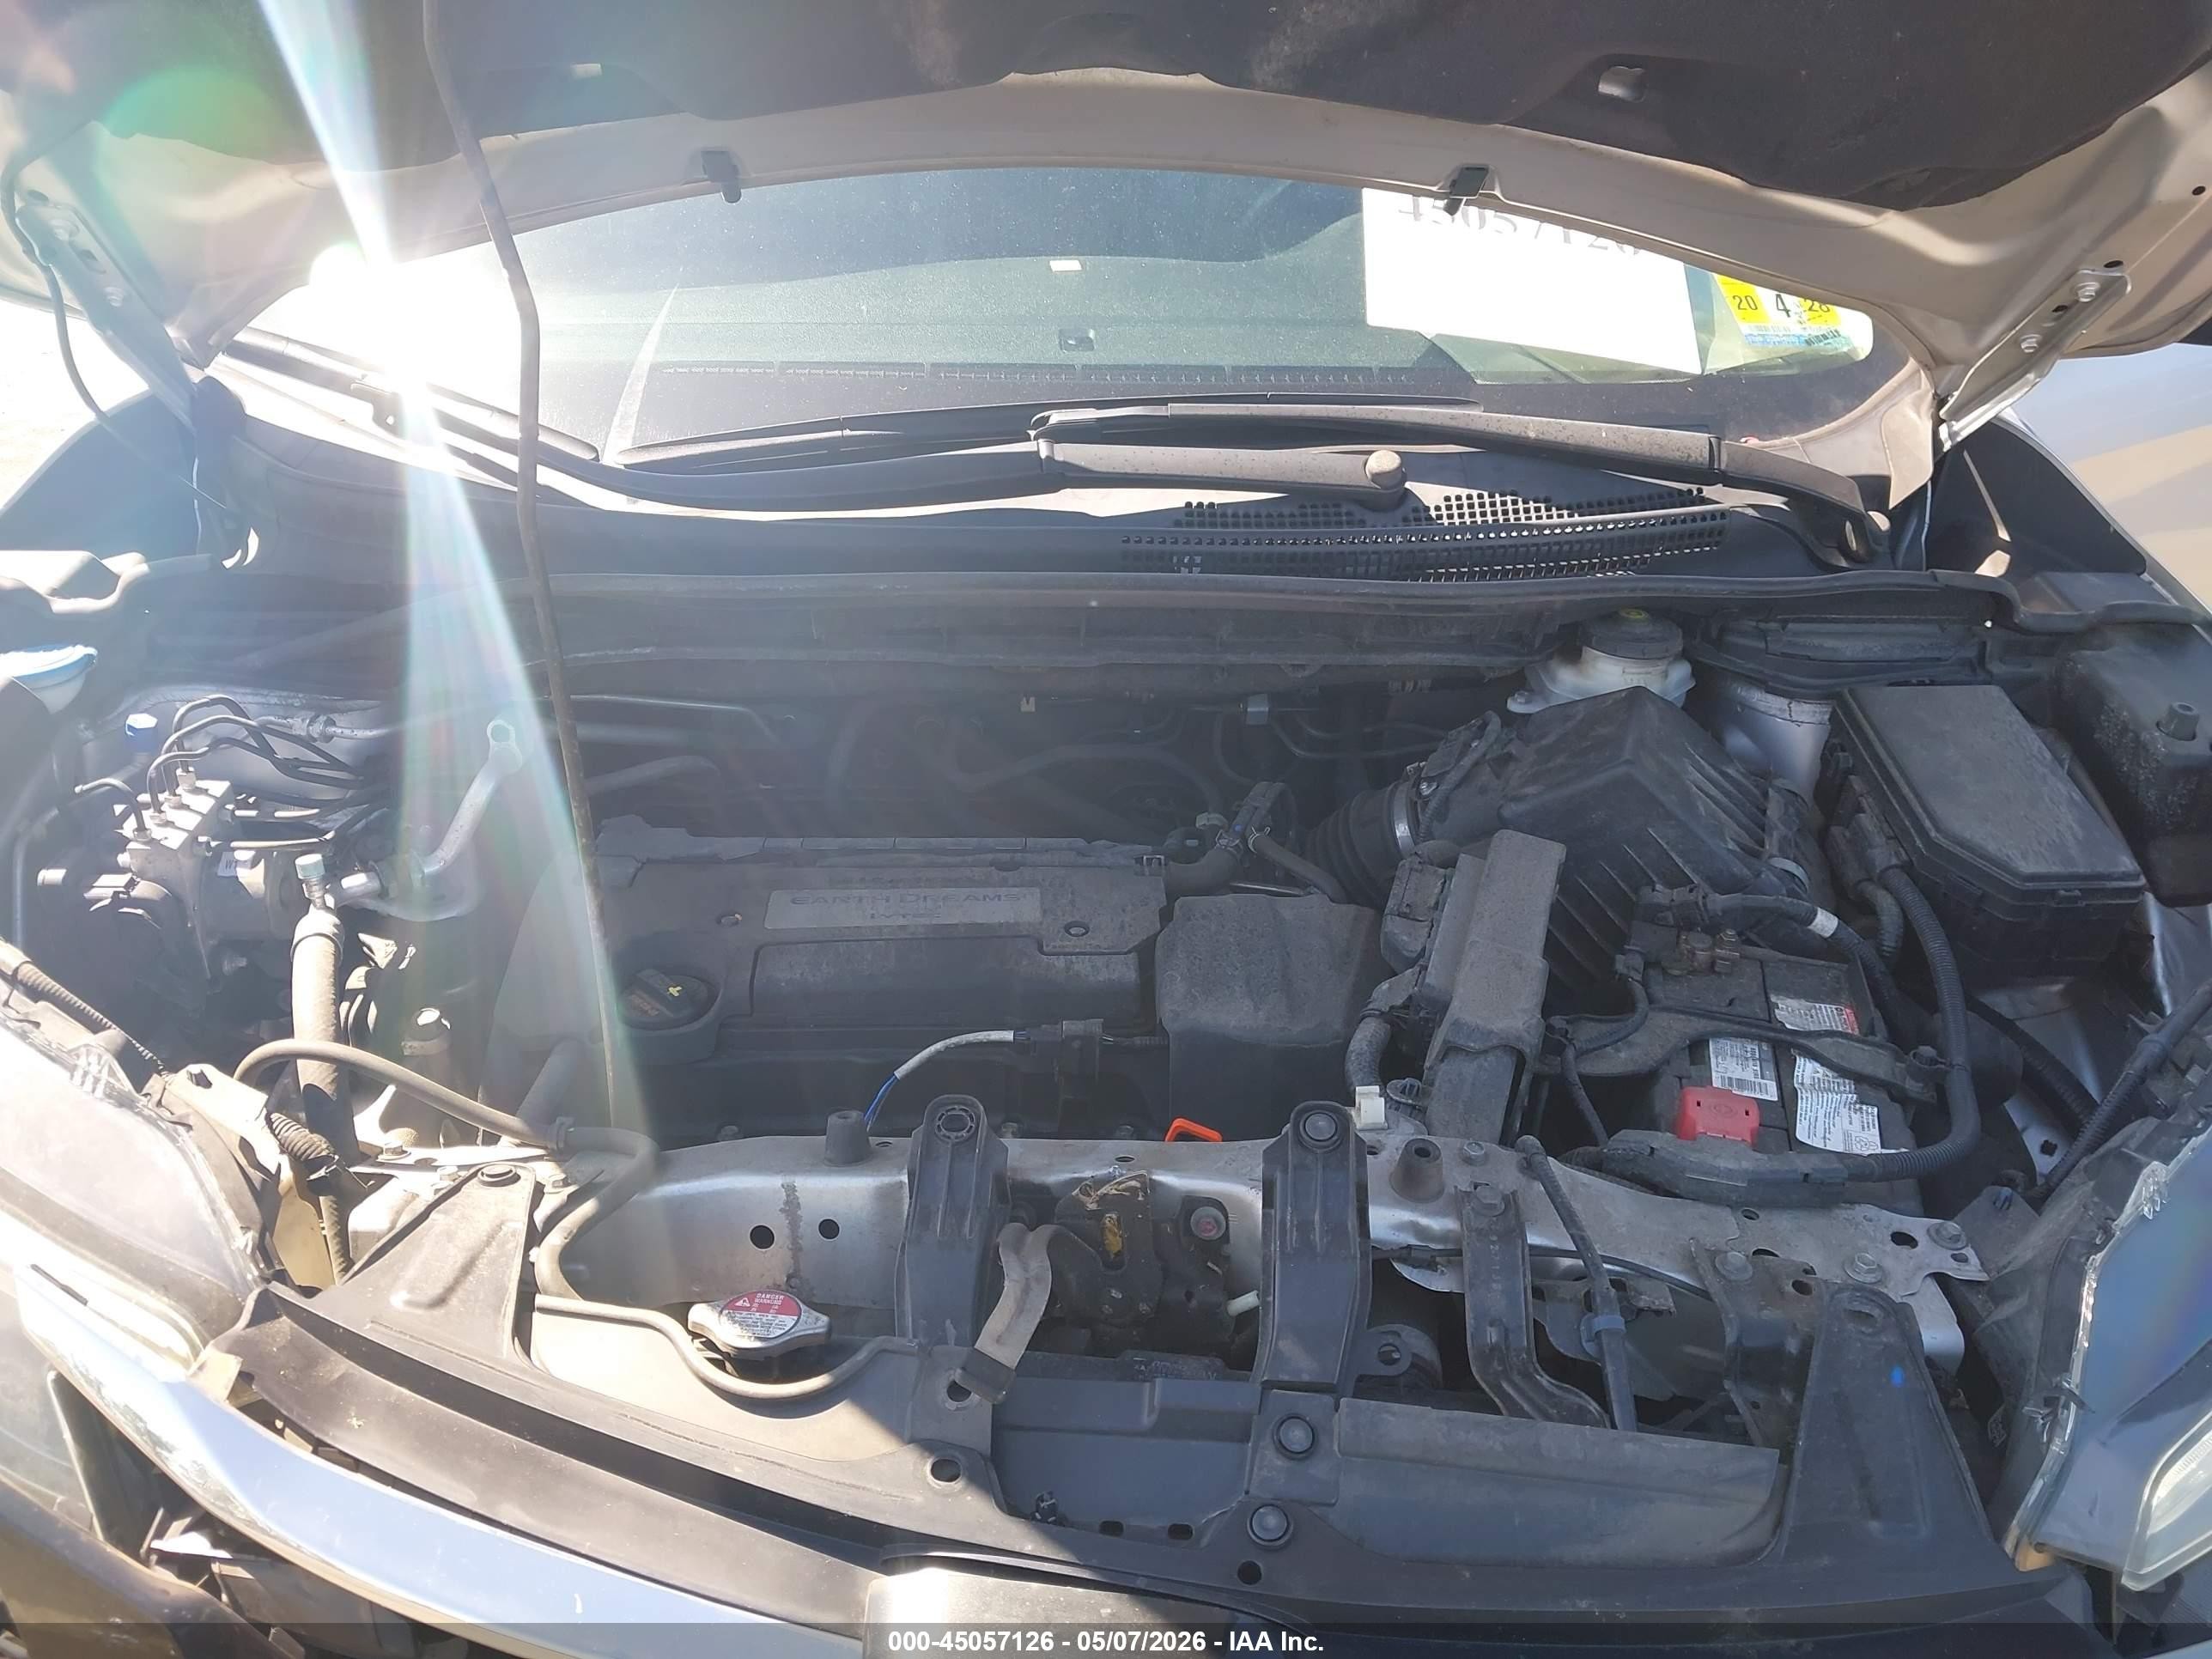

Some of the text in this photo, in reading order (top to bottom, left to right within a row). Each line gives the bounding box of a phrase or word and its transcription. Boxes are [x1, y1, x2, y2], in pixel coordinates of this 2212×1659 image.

[1732, 294, 1759, 311] 20
[1774, 293, 1791, 319] 4
[789, 893, 1021, 905] EARTH DREAMS
